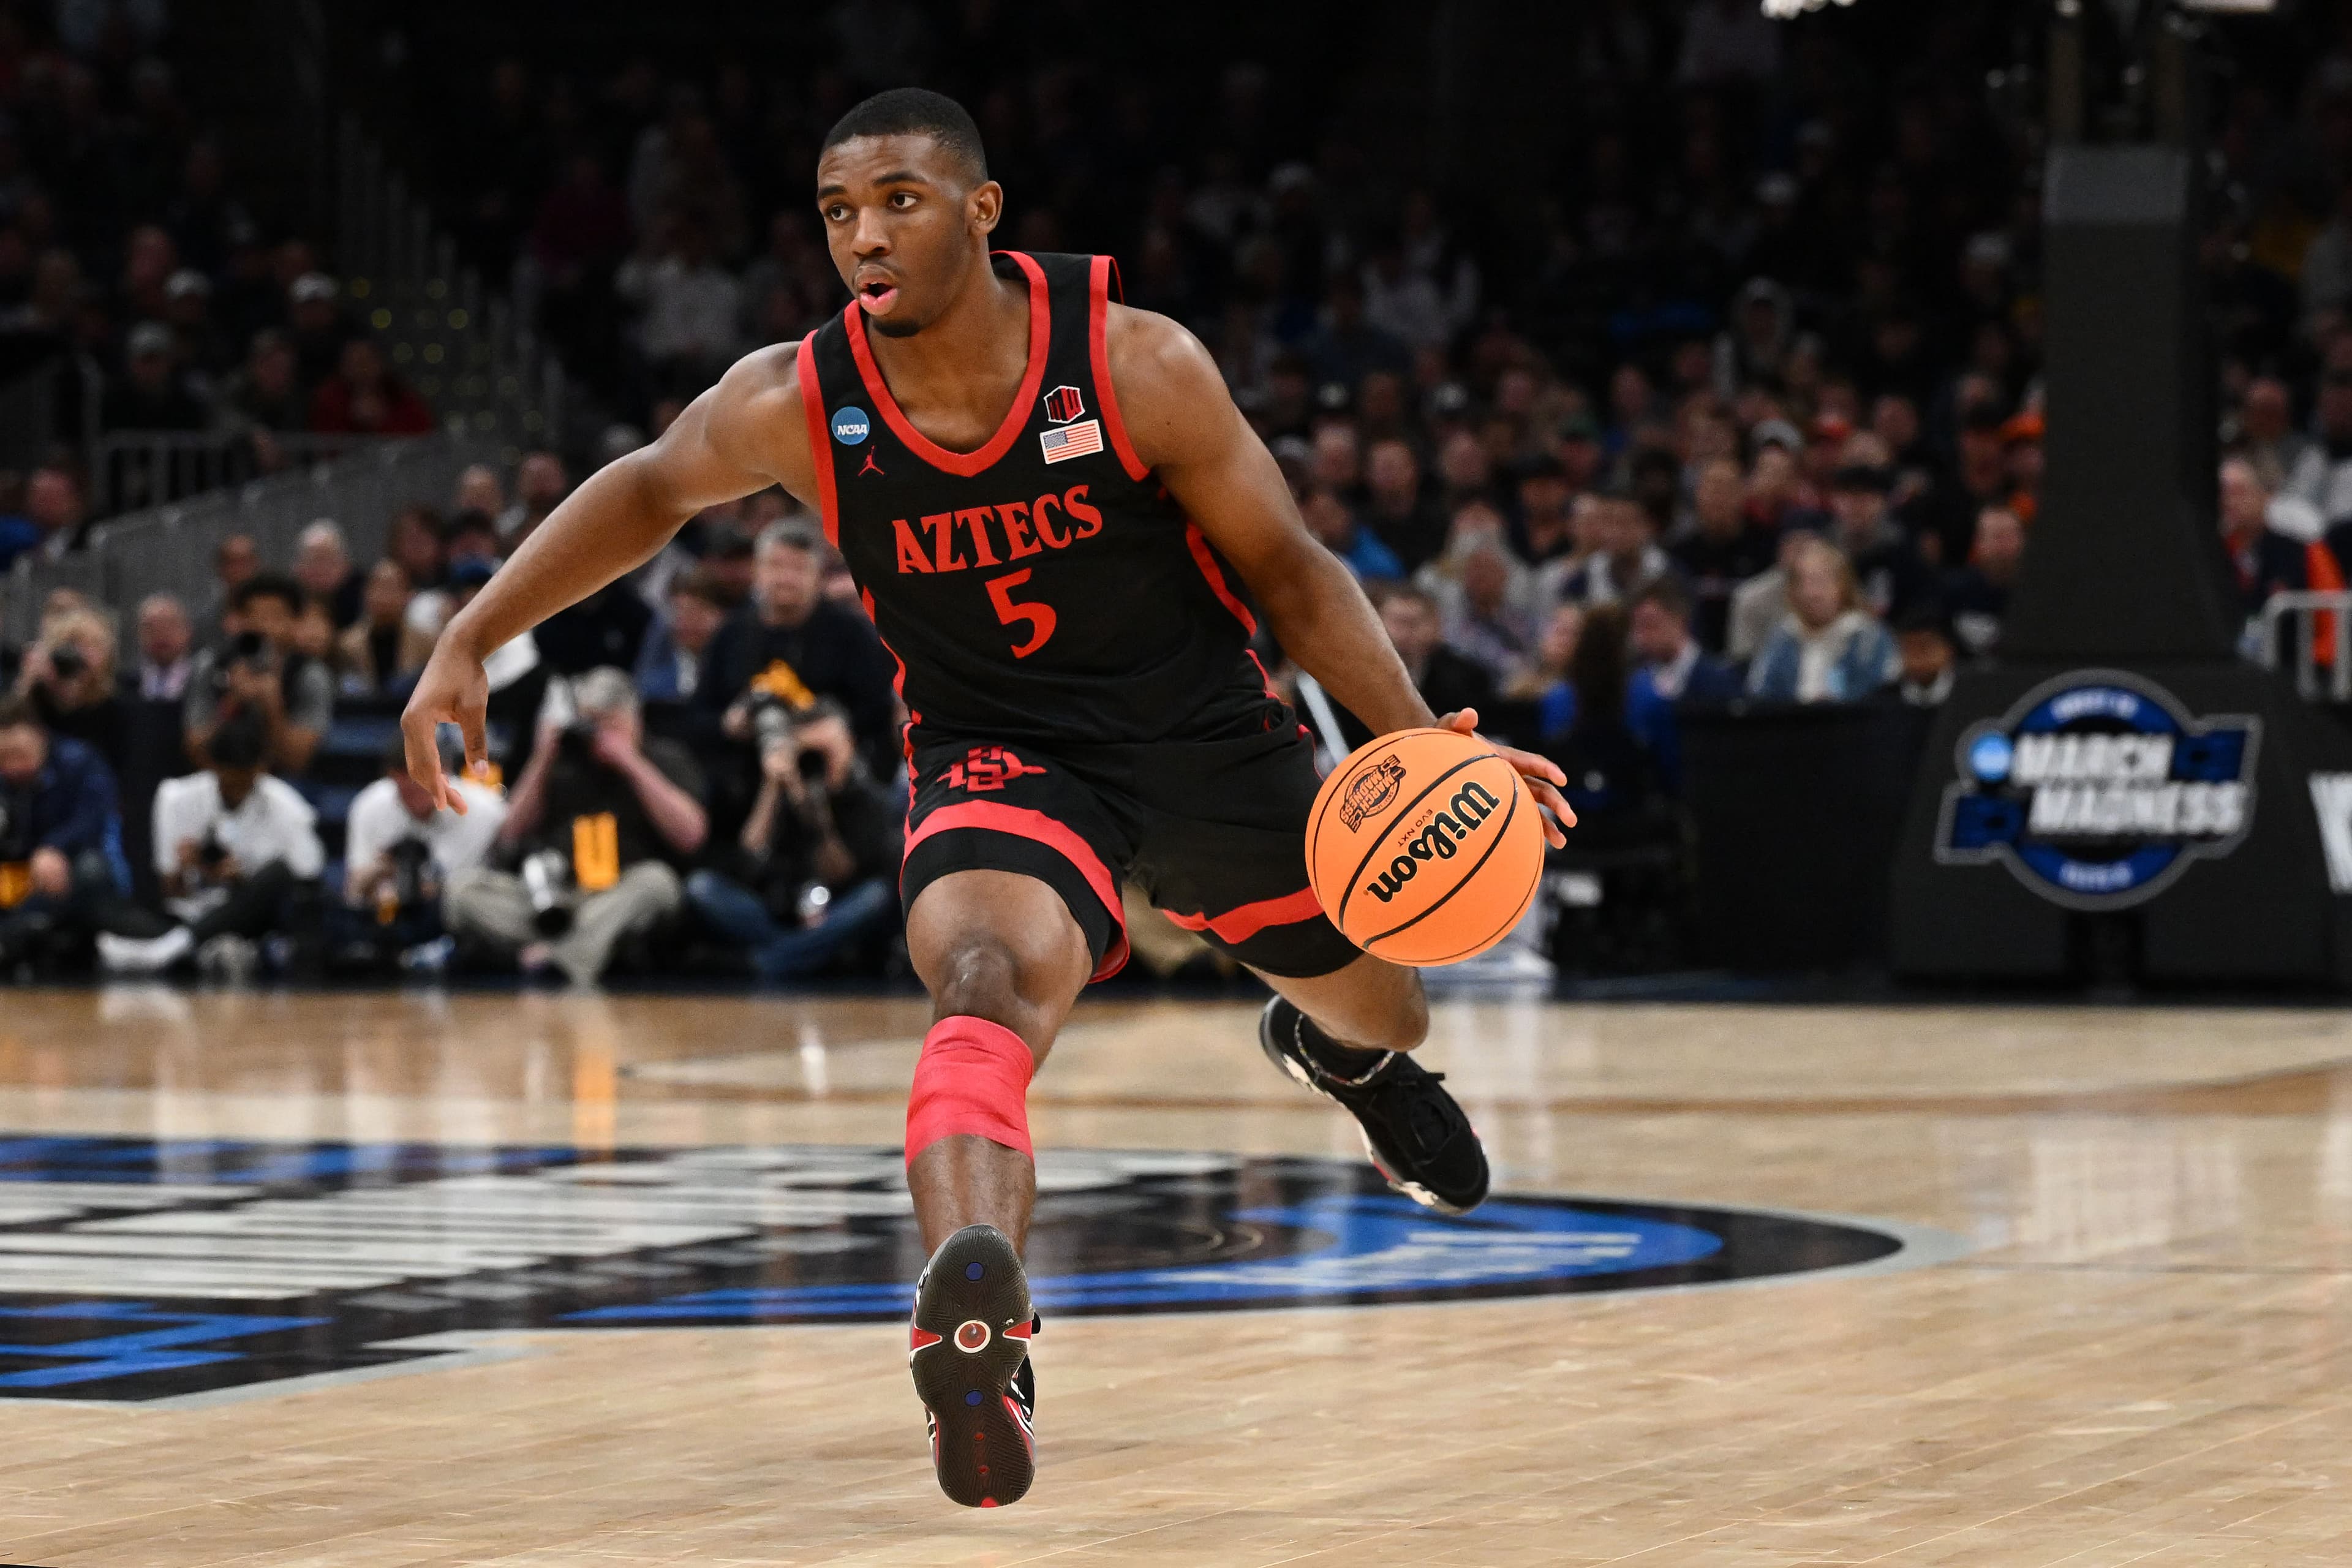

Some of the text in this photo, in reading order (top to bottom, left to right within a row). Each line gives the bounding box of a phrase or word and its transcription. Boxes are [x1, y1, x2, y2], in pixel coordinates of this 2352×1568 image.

[837, 424, 868, 435] NCAA
[892, 484, 1102, 574] AZTECS
[985, 568, 1057, 659] 5
[1340, 769, 1384, 824] MADNESS
[1360, 771, 1396, 812] MARCH
[1366, 781, 1501, 903] Wilson
[1398, 809, 1433, 848] EVO NXT
